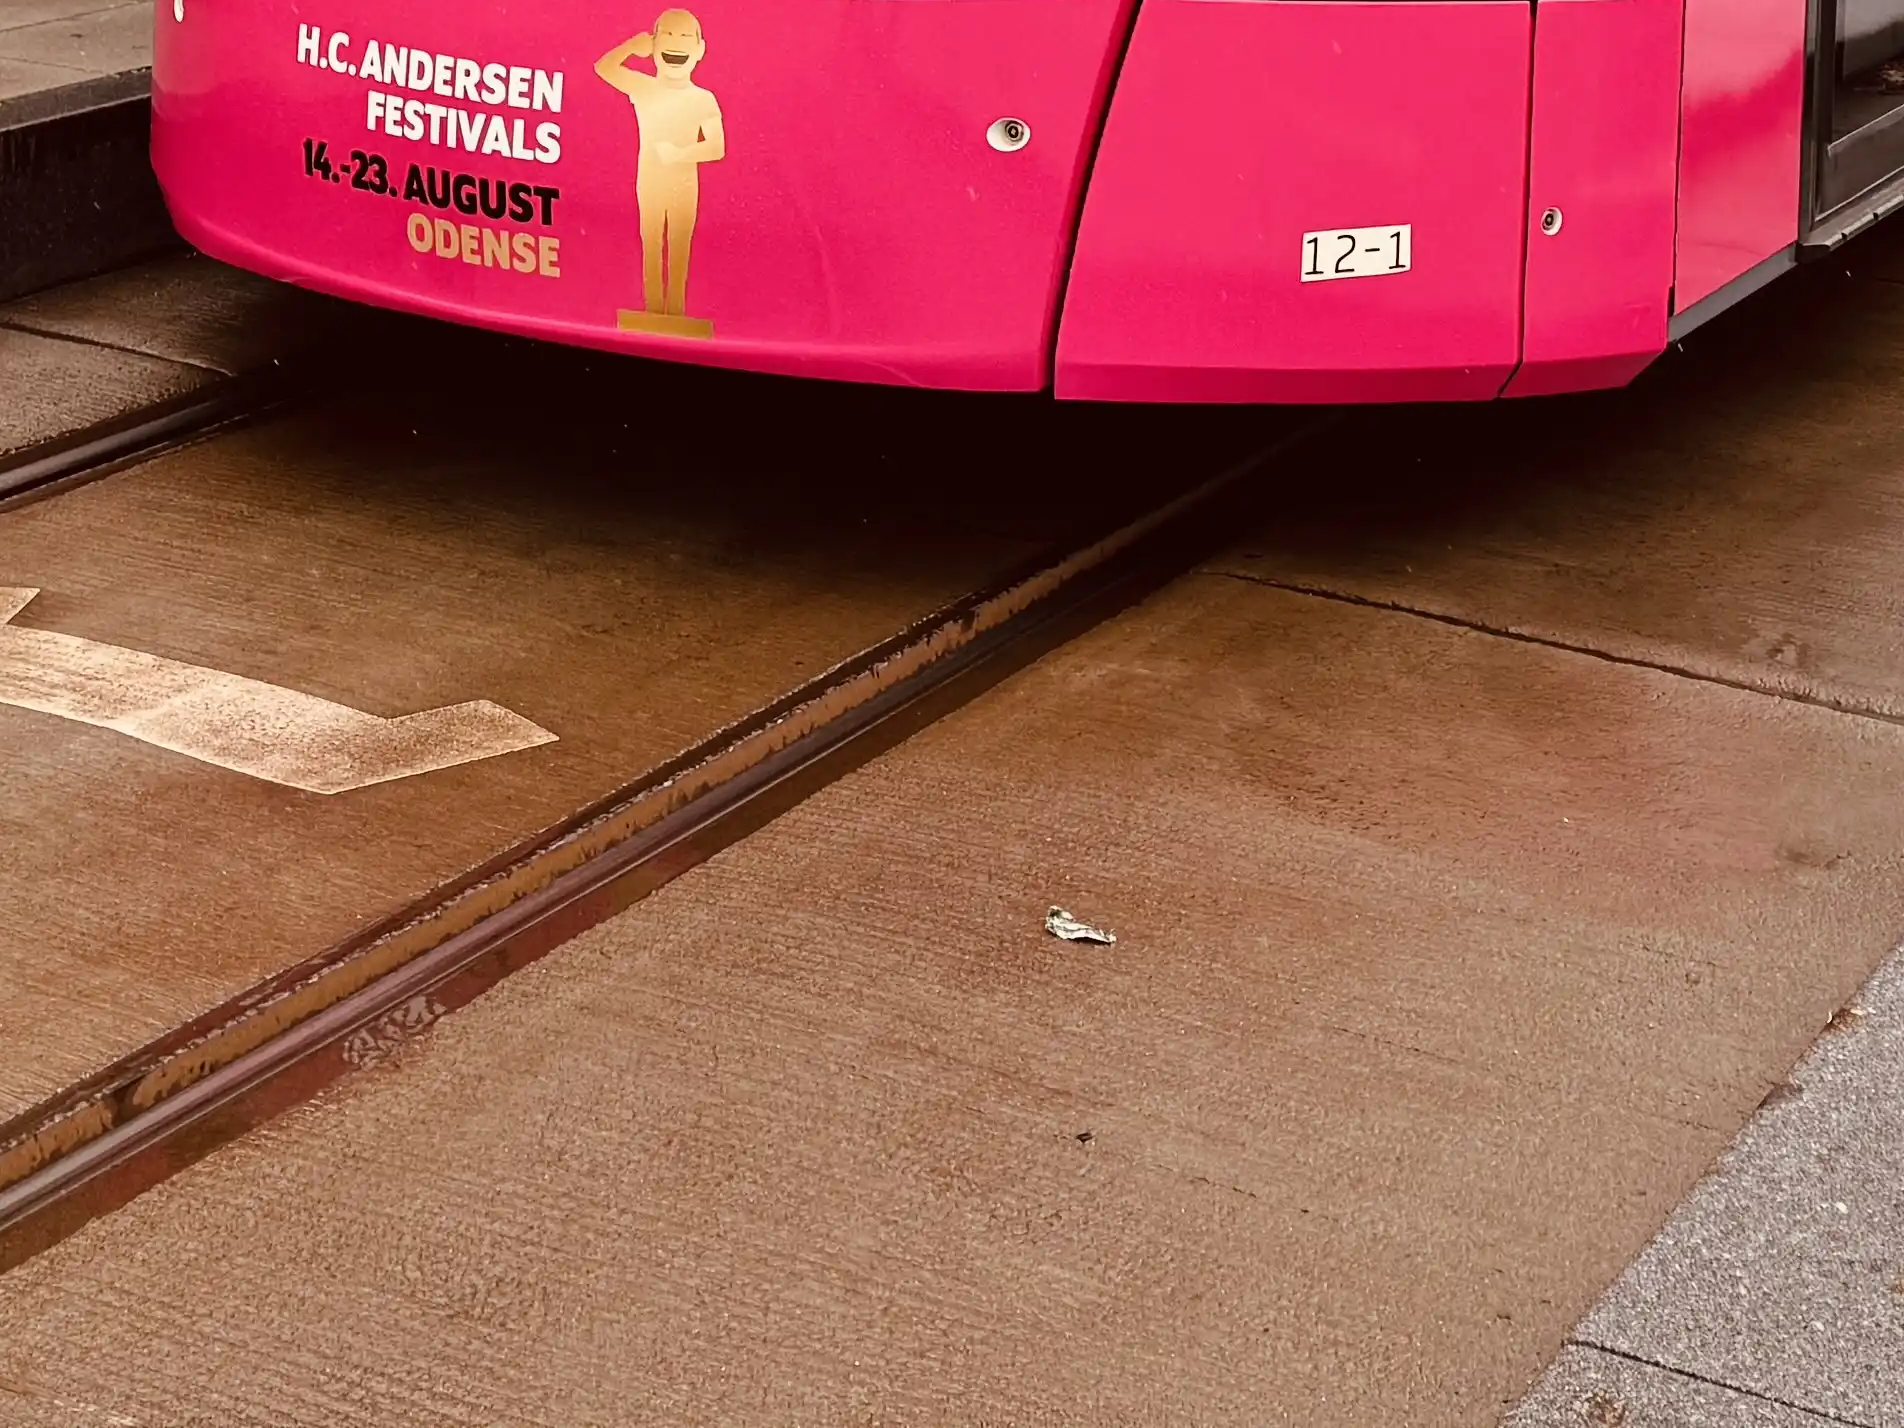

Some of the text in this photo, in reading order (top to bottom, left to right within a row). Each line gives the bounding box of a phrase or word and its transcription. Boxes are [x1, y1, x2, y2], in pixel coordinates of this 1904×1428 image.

[359, 39, 564, 113] ANDERSEN
[366, 90, 561, 164] FESTIVALS
[303, 137, 561, 226] 14.-23. AUGUST
[406, 212, 561, 278] ODENSE
[1304, 231, 1407, 276] 12-1
